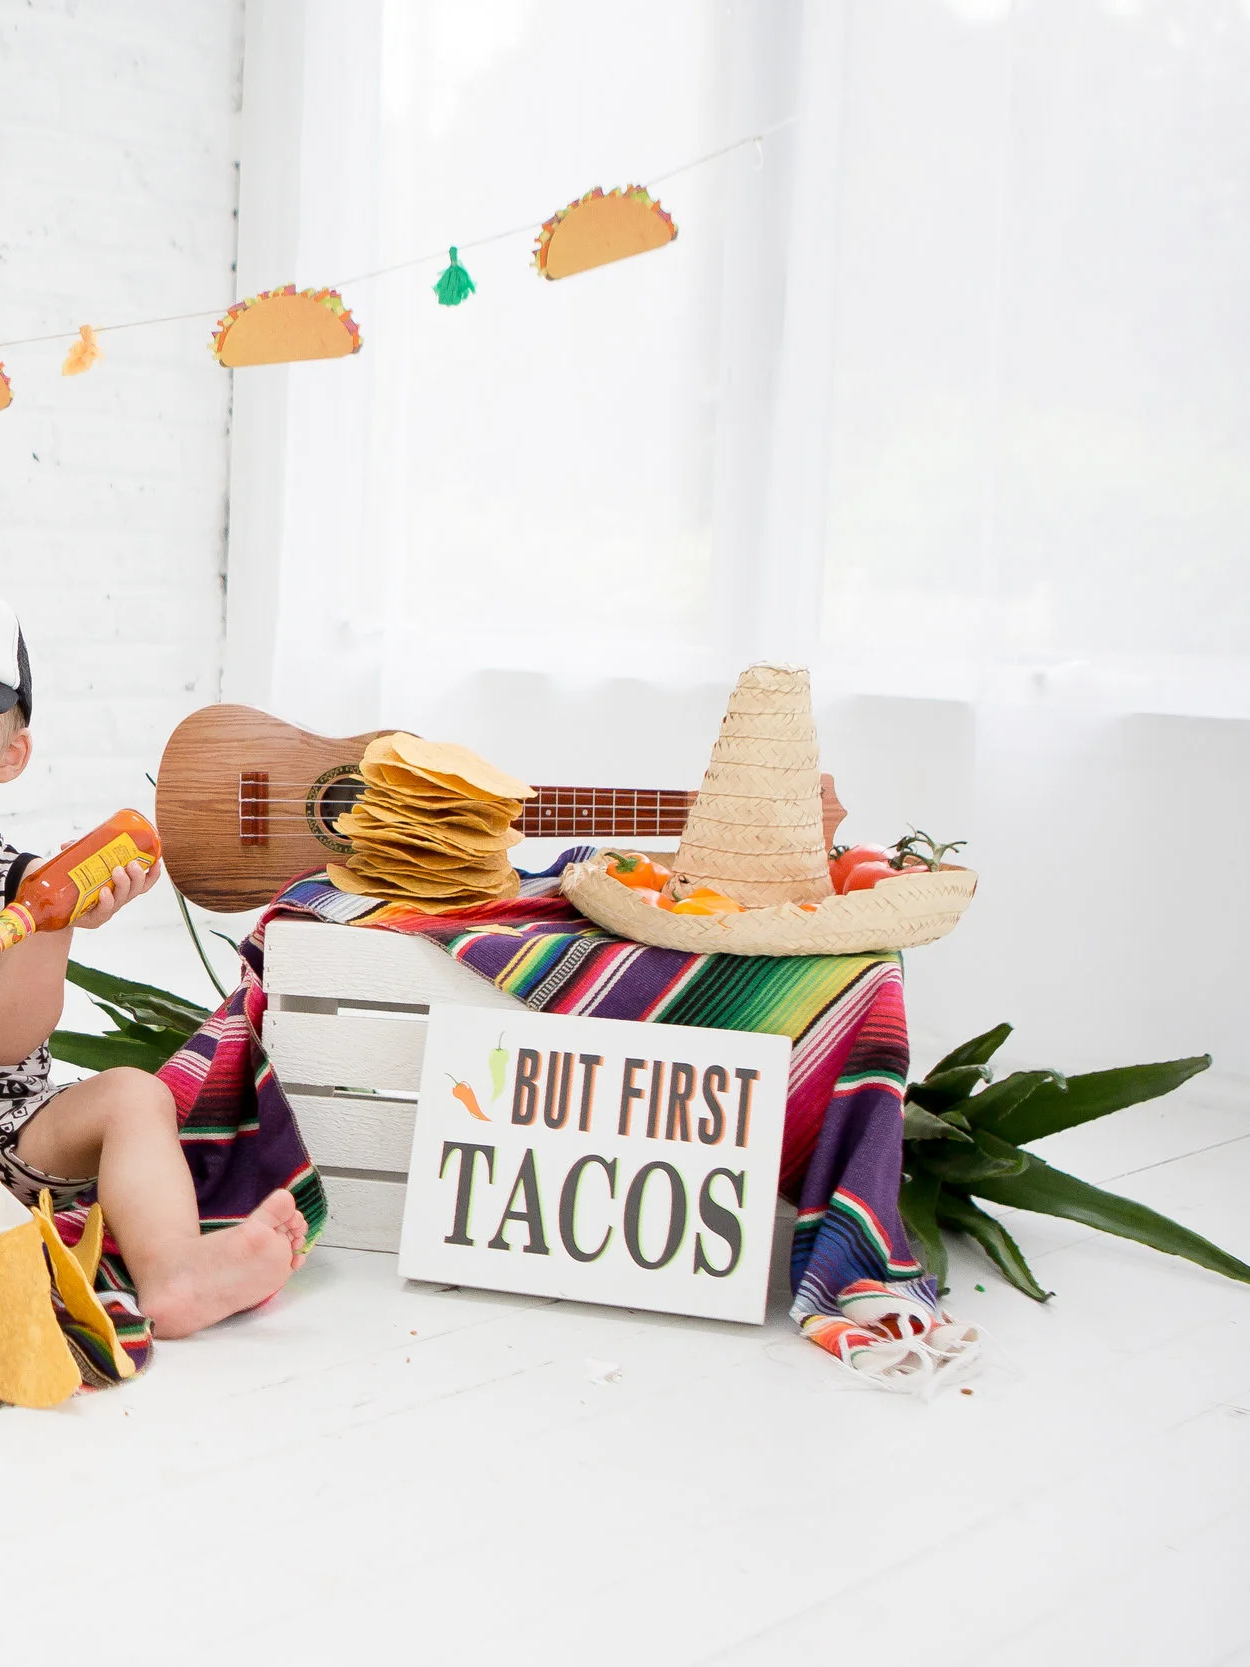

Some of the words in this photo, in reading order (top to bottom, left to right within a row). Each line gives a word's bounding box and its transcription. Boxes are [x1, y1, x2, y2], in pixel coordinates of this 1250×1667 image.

[510, 1047, 605, 1132] BUT
[617, 1057, 761, 1148] FIRST
[438, 1140, 749, 1279] TACOS
